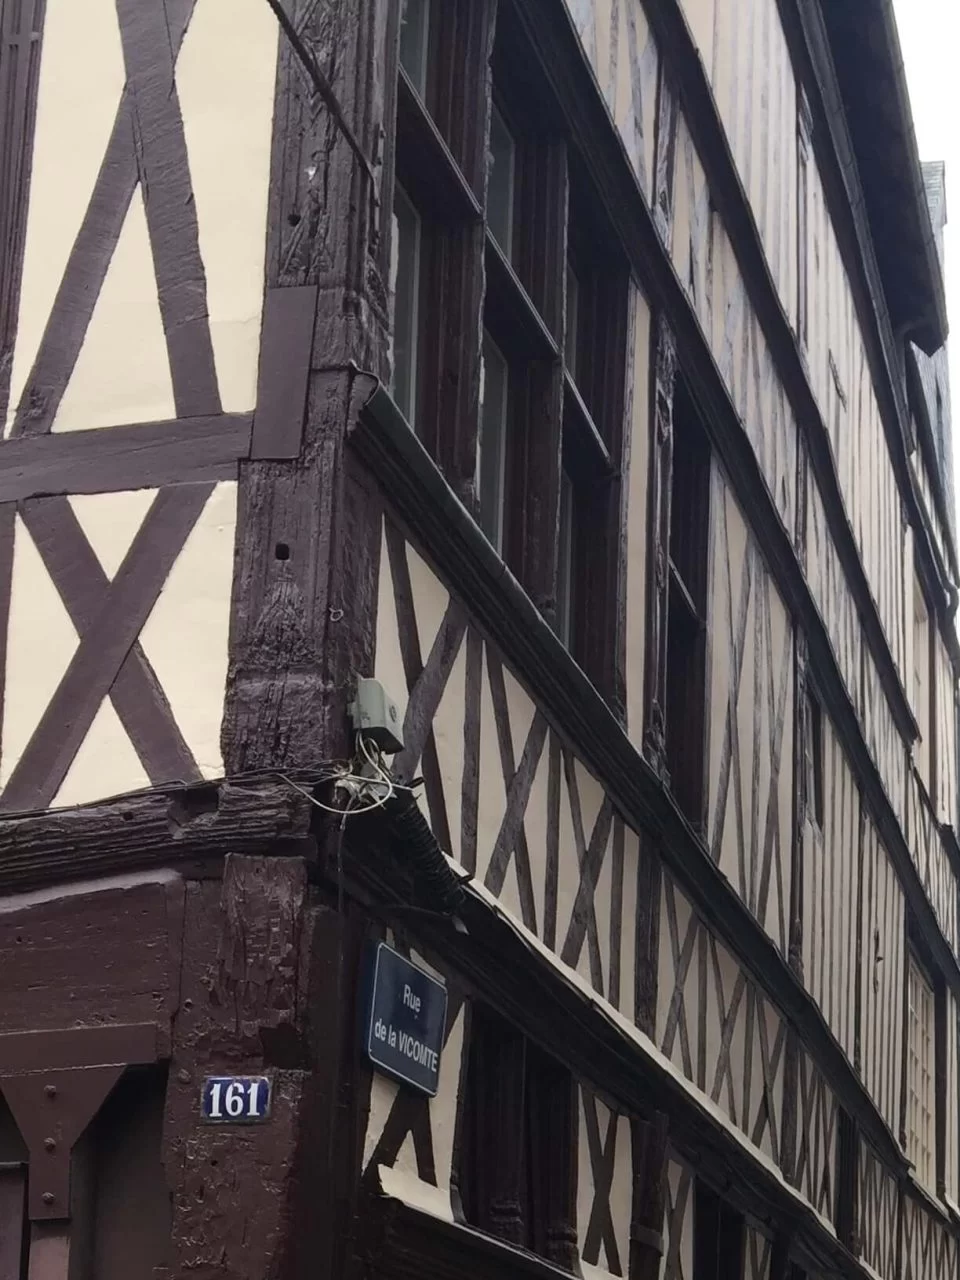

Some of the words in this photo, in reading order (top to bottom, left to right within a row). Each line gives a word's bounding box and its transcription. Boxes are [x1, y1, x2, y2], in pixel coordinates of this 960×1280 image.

[403, 984, 421, 1013] Rue
[374, 1018, 387, 1042] de
[388, 1024, 396, 1048] la
[399, 1030, 439, 1073] VICOMTE
[209, 1082, 260, 1117] 161
